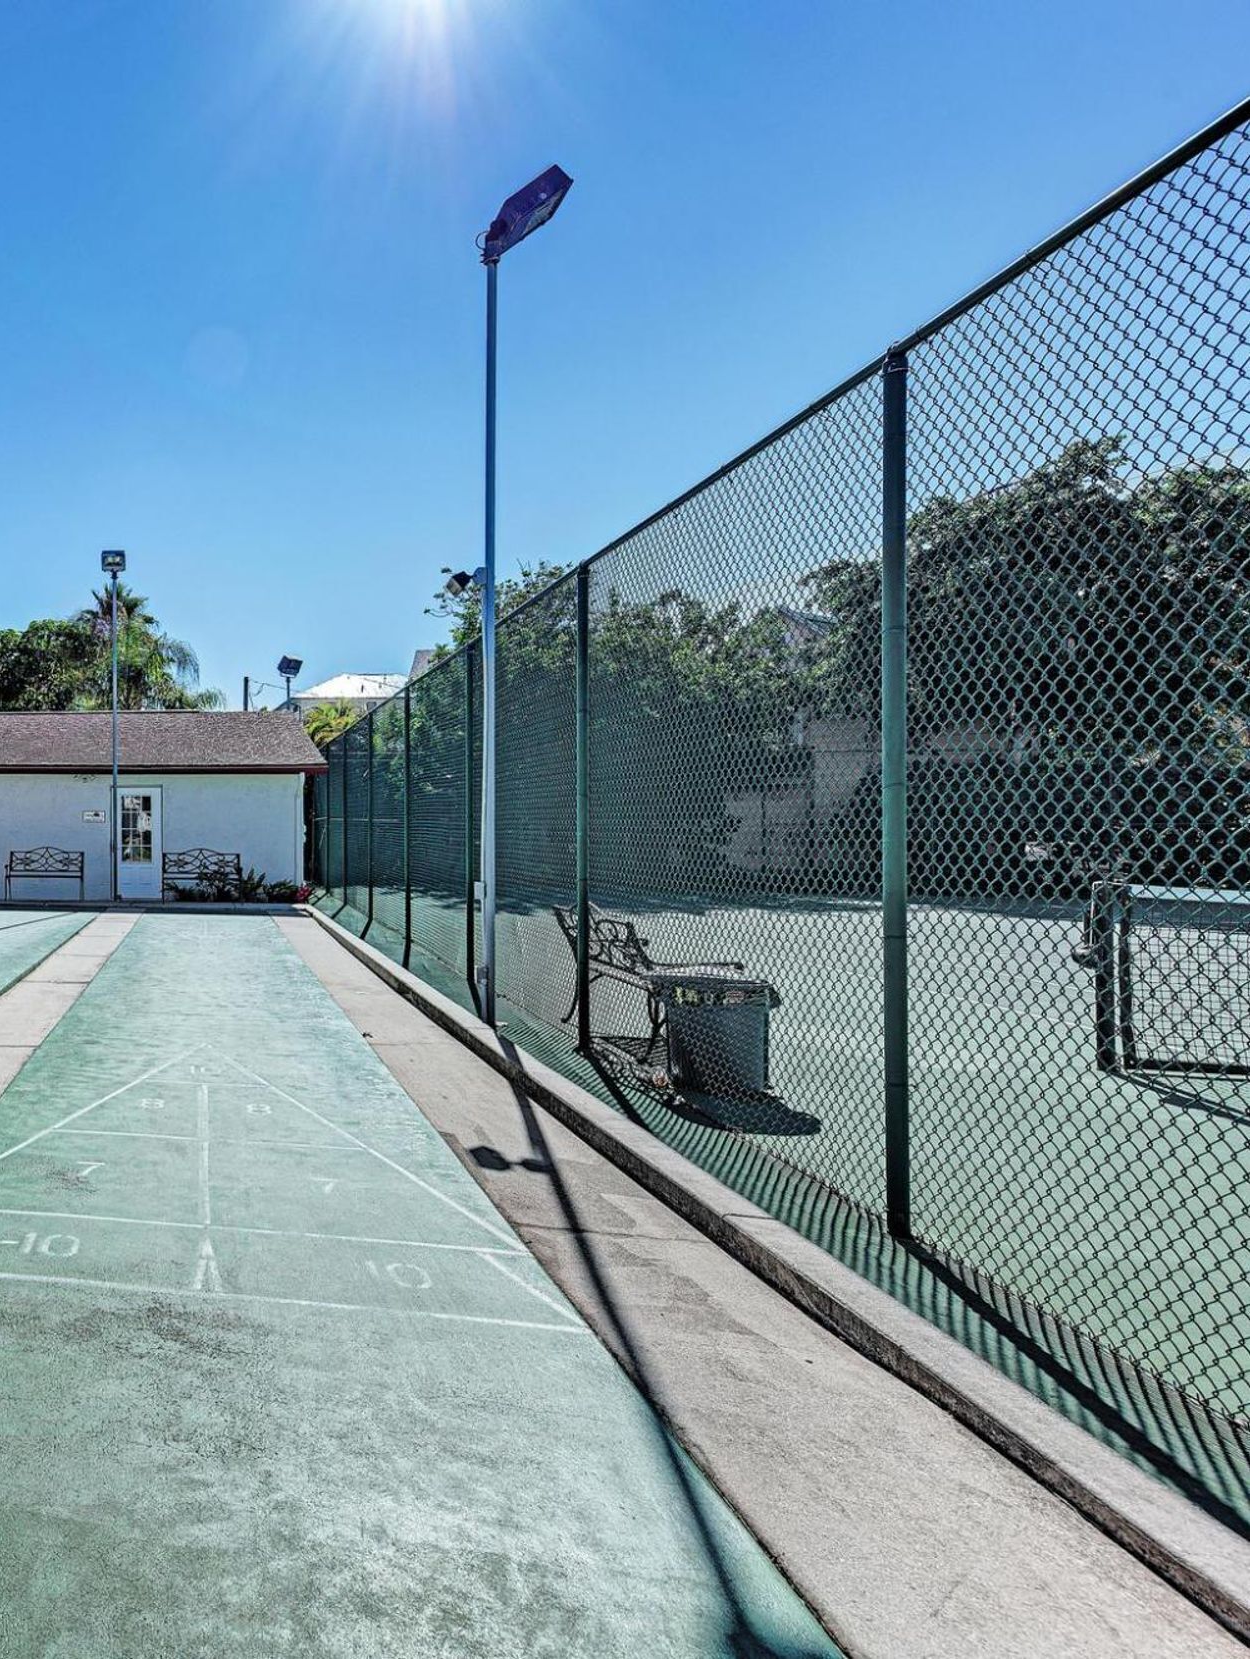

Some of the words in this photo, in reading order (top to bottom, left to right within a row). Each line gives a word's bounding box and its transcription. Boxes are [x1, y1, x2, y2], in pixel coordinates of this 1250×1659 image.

[141, 1098, 165, 1110] 8
[246, 1103, 273, 1115] 8
[76, 1160, 106, 1177] 7
[309, 1175, 340, 1194] 7
[0, 1231, 82, 1259] -10
